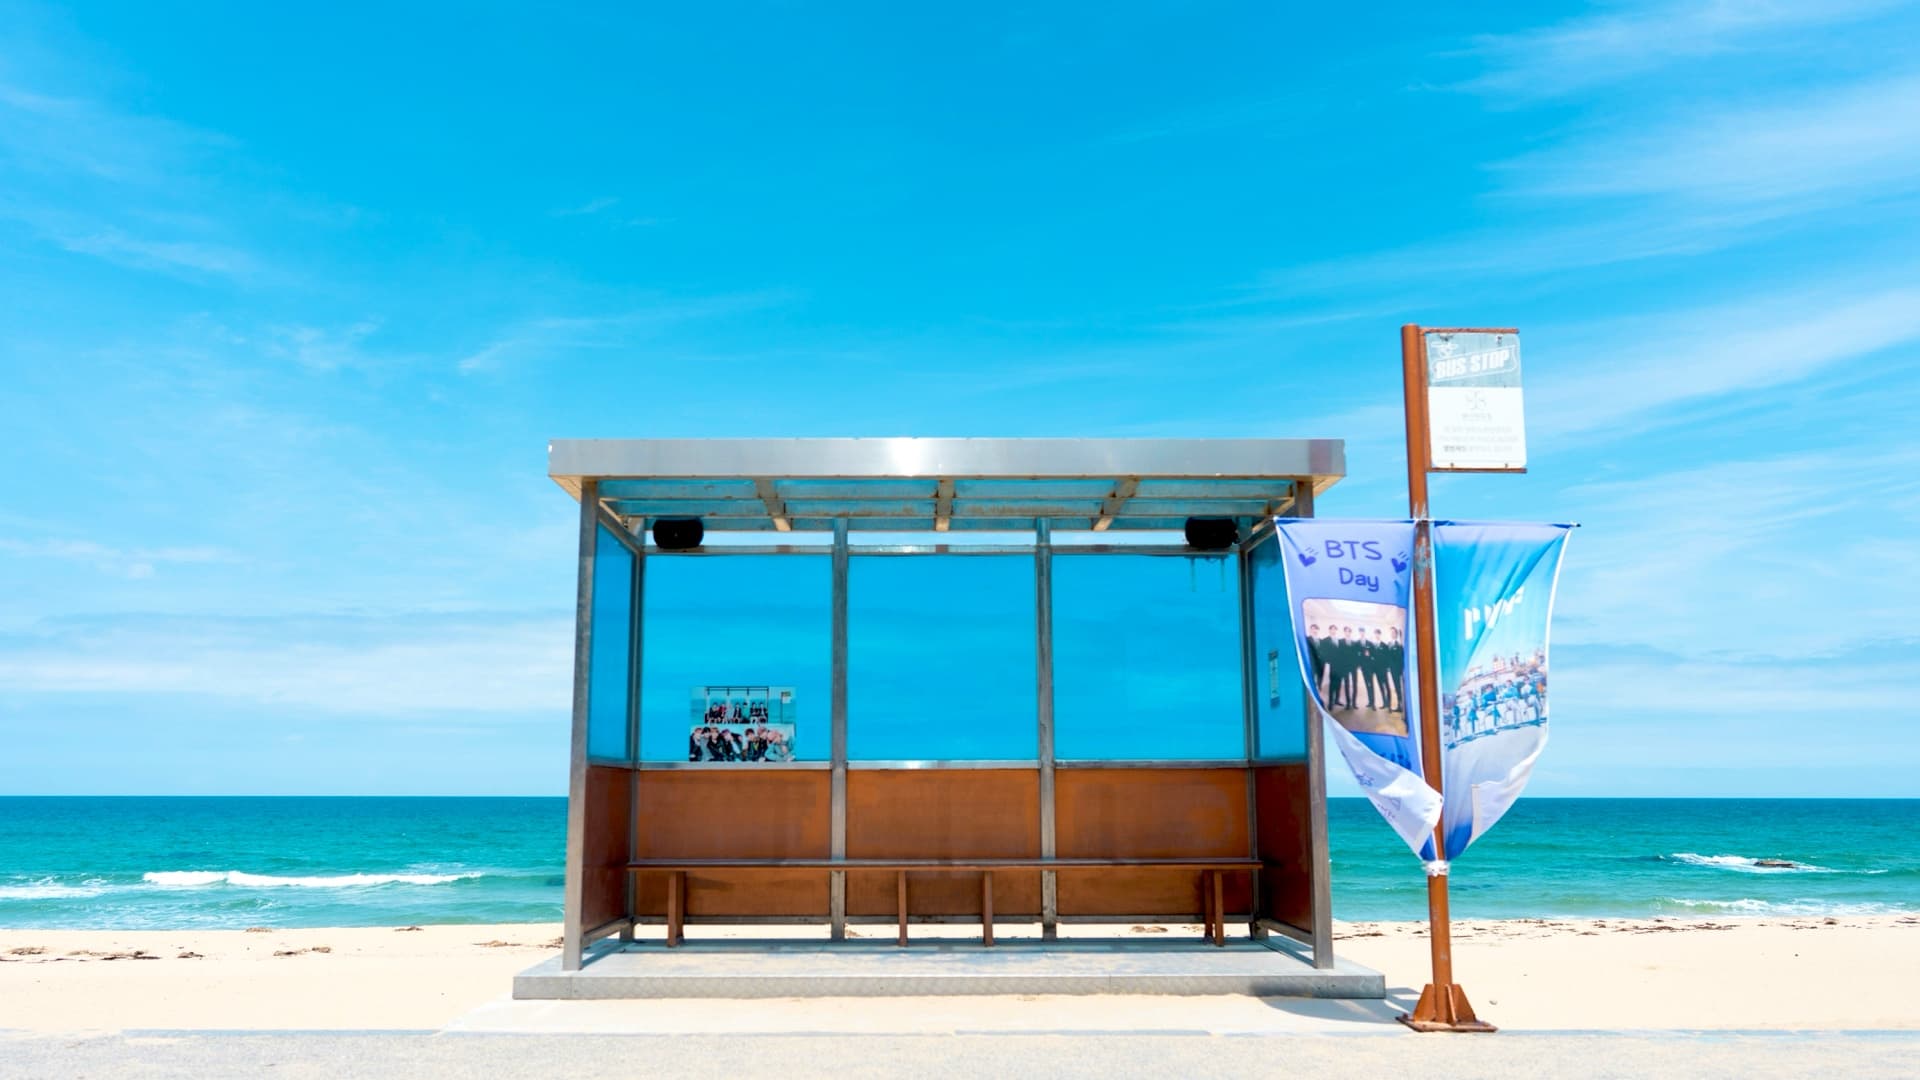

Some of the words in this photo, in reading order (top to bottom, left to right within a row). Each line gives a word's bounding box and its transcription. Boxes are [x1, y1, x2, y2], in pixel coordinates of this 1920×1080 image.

[1435, 357, 1467, 379] BUS
[1470, 349, 1510, 373] STOP
[1325, 540, 1383, 560] BTS
[1339, 567, 1379, 592] Day
